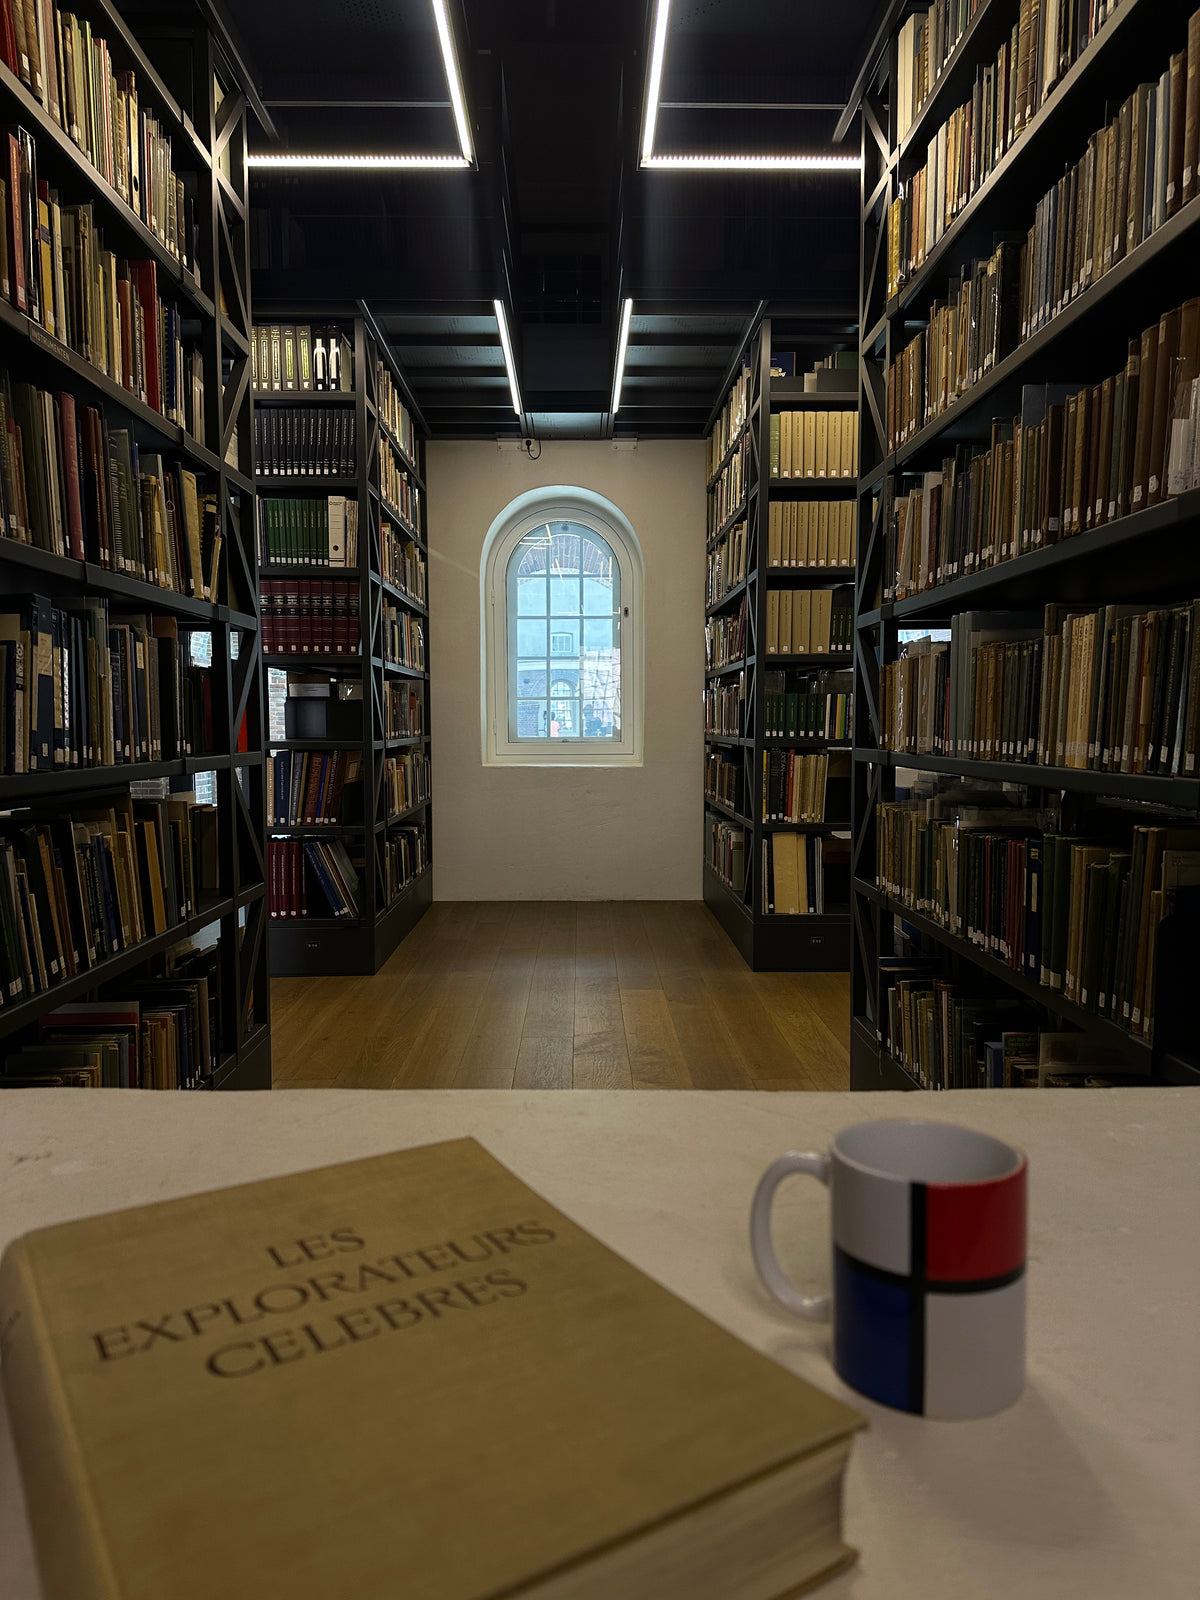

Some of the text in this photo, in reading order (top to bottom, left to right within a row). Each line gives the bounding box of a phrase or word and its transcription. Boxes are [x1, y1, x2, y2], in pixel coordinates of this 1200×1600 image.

[93, 1219, 557, 1363] EXPLORATEURS
[267, 1226, 366, 1269] LES
[205, 1268, 528, 1379] CELEBRES
